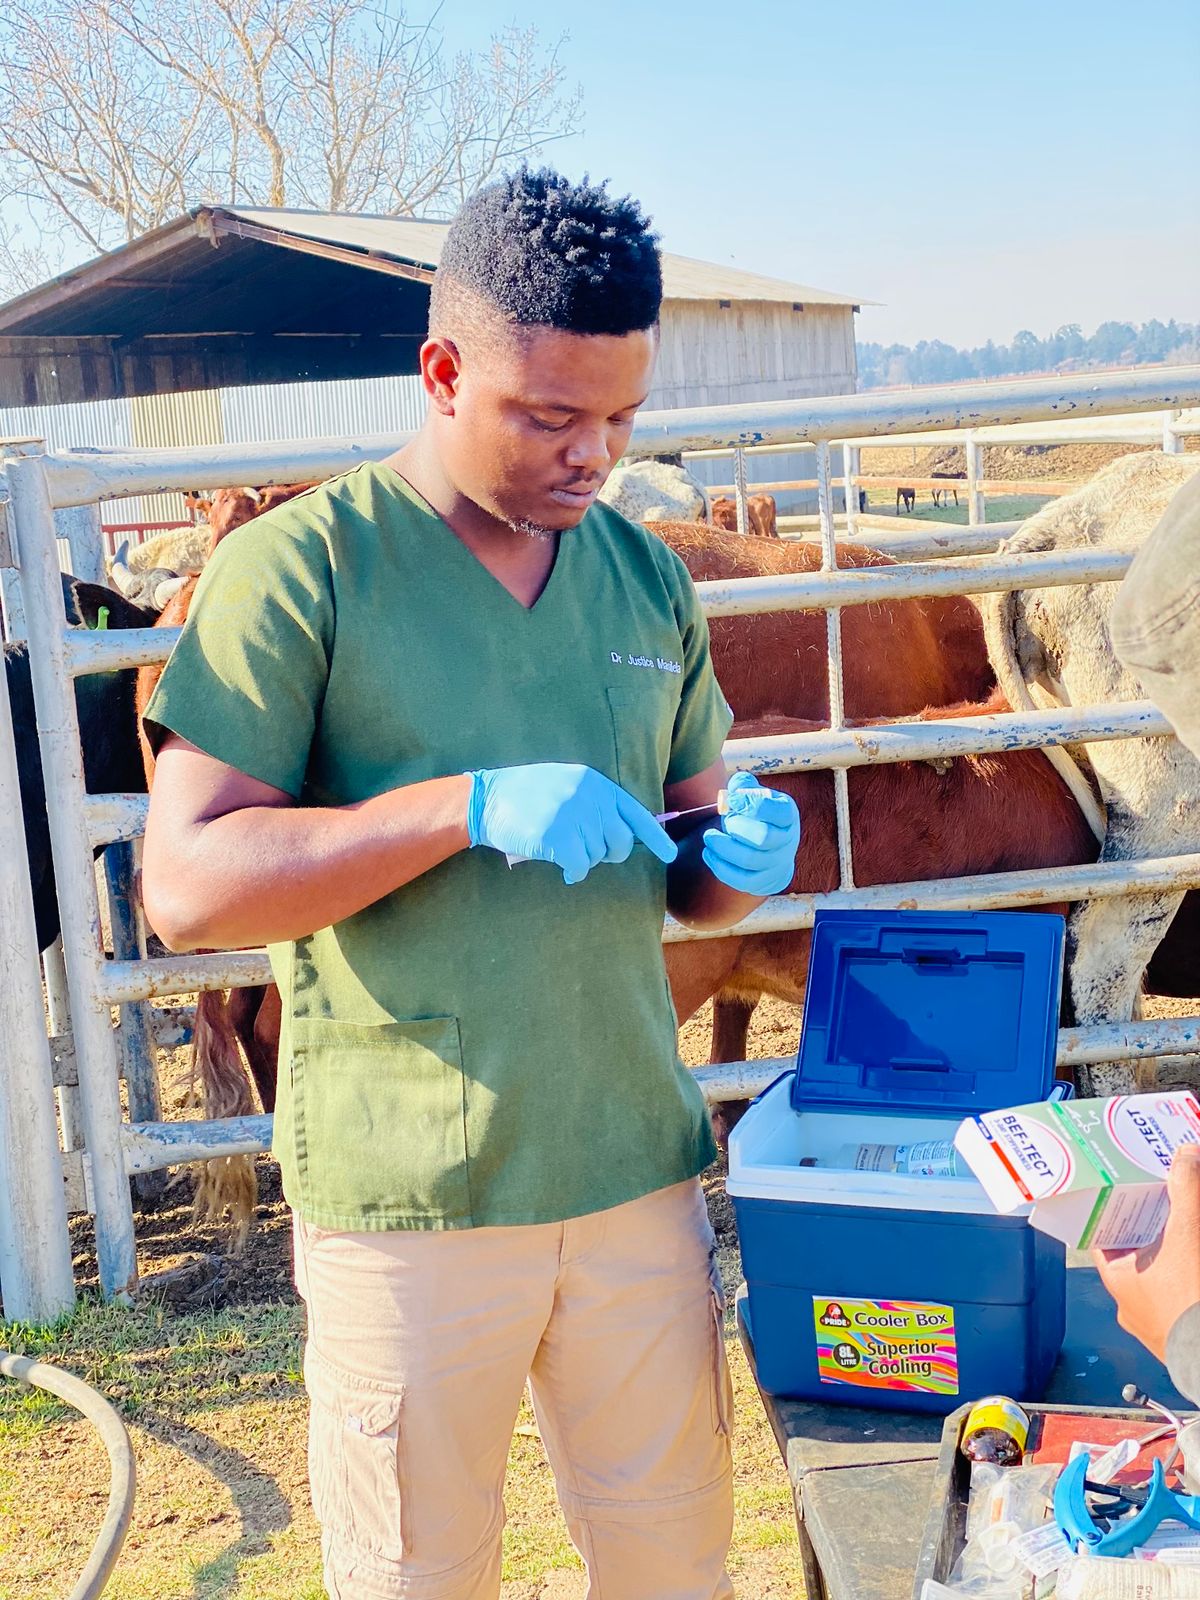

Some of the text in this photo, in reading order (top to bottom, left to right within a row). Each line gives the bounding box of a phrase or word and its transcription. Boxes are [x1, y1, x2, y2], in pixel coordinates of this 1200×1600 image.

[611, 652, 622, 664] Dr
[628, 654, 655, 668] Justice
[1002, 1115, 1054, 1177] BEF-TECT
[1126, 1108, 1171, 1172] EF-TECT
[824, 1317, 847, 1327] PRIDE
[854, 1312, 948, 1327] Cooler Box
[867, 1339, 937, 1359] Superior
[868, 1359, 932, 1377] Cooling
